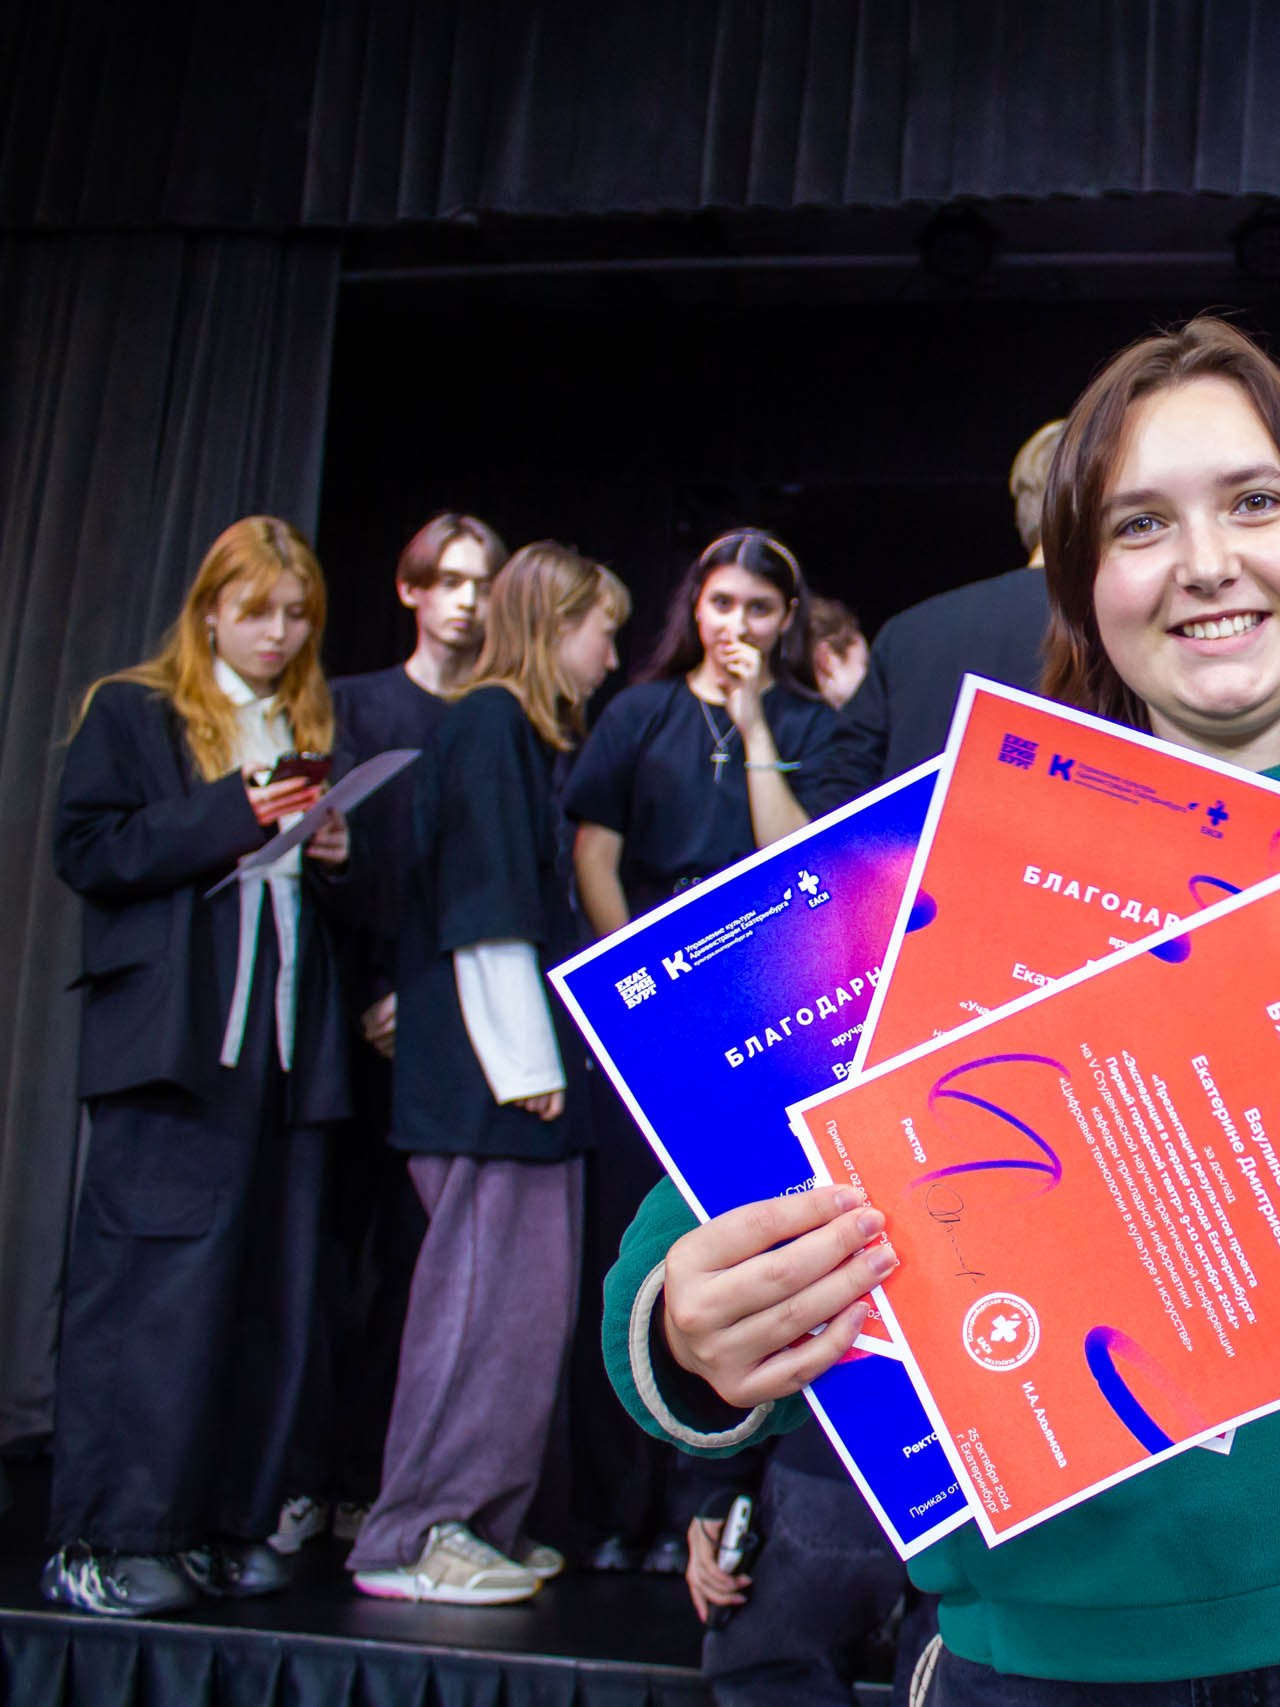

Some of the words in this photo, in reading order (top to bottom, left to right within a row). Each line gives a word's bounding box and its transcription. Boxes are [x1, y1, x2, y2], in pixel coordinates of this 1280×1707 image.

[1047, 753, 1075, 781] К
[684, 927, 725, 954] Управление
[724, 909, 757, 931] культуры
[688, 926, 741, 959] Администрации
[739, 898, 789, 930] Екатеринбурга
[614, 966, 650, 992] ЕКАТ
[618, 974, 655, 1000] ЕРИН
[661, 949, 693, 981] К
[623, 982, 658, 1009] БУРГ
[1079, 1042, 1092, 1059] на
[1087, 1057, 1100, 1069] V
[1057, 1075, 1096, 1145] «Цифровые
[1091, 1068, 1139, 1153] Студенческой
[1119, 1048, 1166, 1132] «Экспедиция
[1189, 1053, 1247, 1155] Екатерине
[824, 1118, 849, 1159] Приказ
[842, 1158, 855, 1171] от
[898, 1115, 929, 1164] Ректор
[1158, 1130, 1169, 1141] в
[1203, 1145, 1215, 1160] за
[1090, 1144, 1128, 1212] технологии
[1149, 1072, 1199, 1162] «Презентация
[1189, 1160, 1234, 1238] результатов
[1227, 1236, 1258, 1288] проекта
[1162, 1140, 1191, 1188] сердце
[1208, 1159, 1236, 1204] доклад
[1089, 1105, 1122, 1159] кафедры
[1114, 1158, 1156, 1230] прикладной
[1148, 1229, 1193, 1309] информатики
[1103, 1055, 1136, 1107] Первый
[1127, 1104, 1167, 1171] городской
[1158, 1169, 1185, 1215] театр»
[1178, 1213, 1199, 1242] 9-10
[1192, 1240, 1224, 1293] октября
[1216, 1291, 1241, 1329] 2024»
[1122, 1212, 1132, 1222] в
[1131, 1152, 1199, 1279] научно-практической
[1184, 1186, 1212, 1232] города
[1125, 1221, 1158, 1276] культуре
[1152, 1275, 1163, 1286] и
[1205, 1229, 1258, 1325] Екатеринбурга:
[1156, 1285, 1194, 1352] искусстве»
[1191, 1278, 1236, 1358] конференции
[956, 1432, 966, 1446] г.
[1020, 1380, 1041, 1408] И.А.
[1032, 1406, 1069, 1468] Ахьямова
[958, 1440, 1000, 1514] Екатеринбург
[966, 1427, 980, 1442] 25
[973, 1440, 1000, 1484] октября
[993, 1483, 1012, 1510] 2024
[908, 1492, 951, 1520] Приказ
[946, 1481, 962, 1495] от
